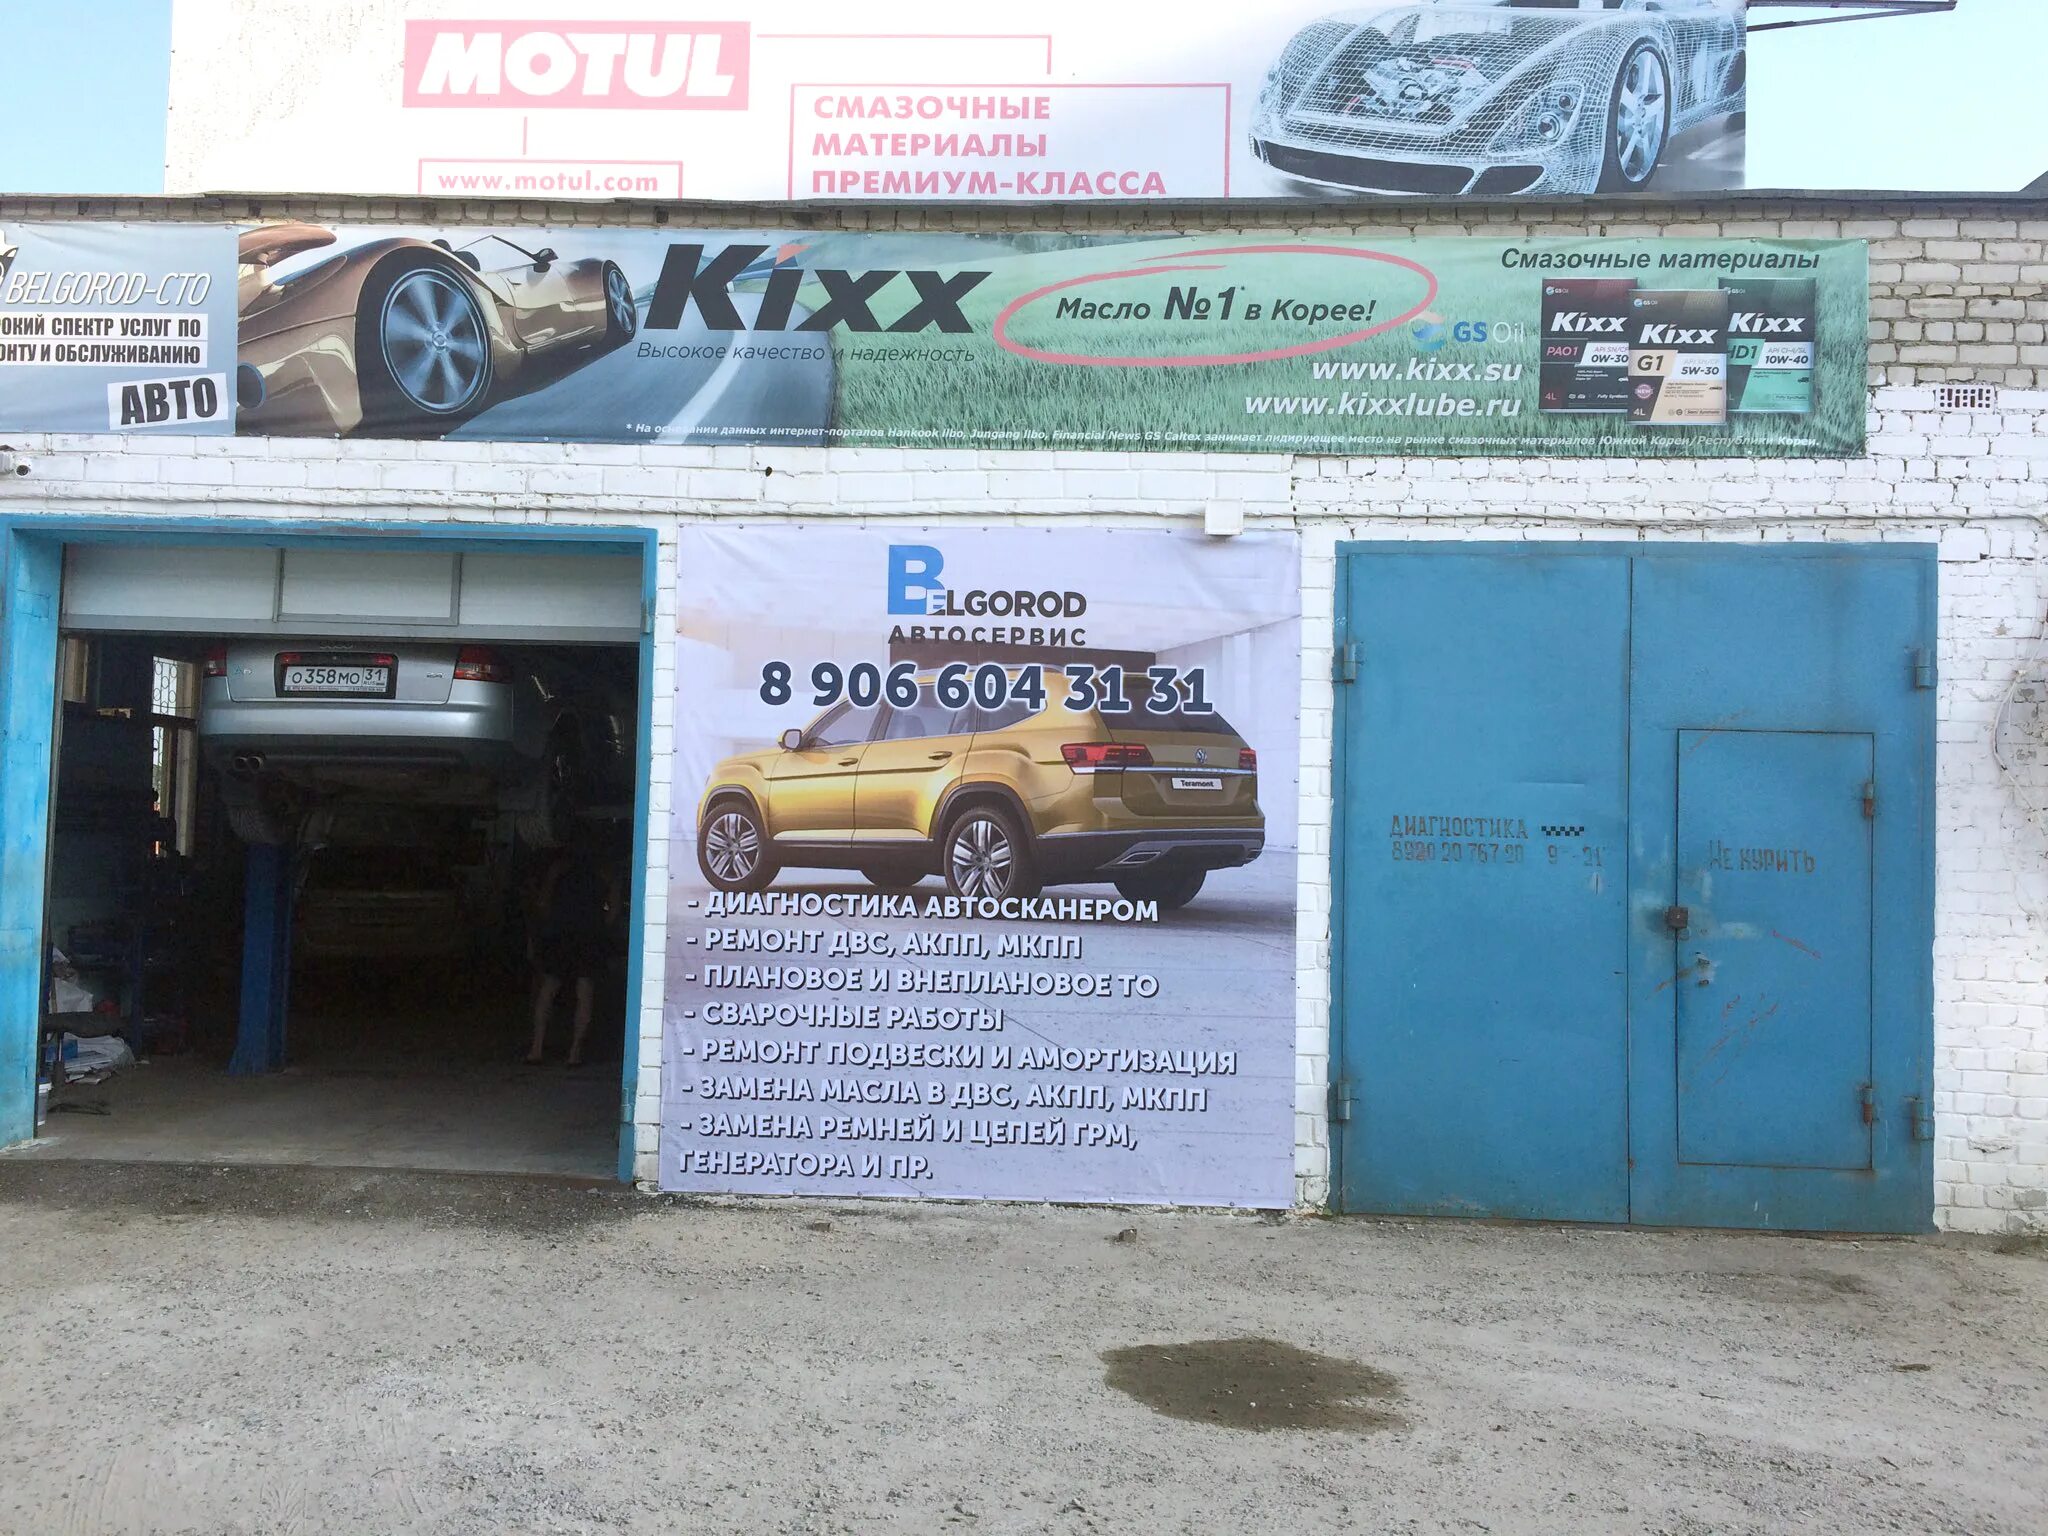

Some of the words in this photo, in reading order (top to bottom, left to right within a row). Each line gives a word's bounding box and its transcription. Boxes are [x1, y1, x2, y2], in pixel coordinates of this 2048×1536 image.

[418, 31, 736, 98] MOTUL
[813, 95, 1051, 120] СМАЗОЧНЫЕ
[812, 133, 1047, 157] МАТЕРИАЛЫ
[437, 169, 659, 193] www.motul.com
[812, 170, 1167, 196] ПРЕМИУМ-КЛАССА
[1501, 247, 1651, 269] Смазочные
[1658, 253, 1820, 272] материалы
[643, 243, 993, 334] Kixx
[1056, 297, 1151, 320] Масло
[1245, 303, 1261, 321] в
[1271, 299, 1377, 326] Корее!
[1550, 312, 1628, 332] Kixx
[1727, 312, 1806, 333] Kixx
[0, 313, 45, 336] ОКИЙ
[51, 317, 114, 336] СПЕКТР
[120, 318, 172, 337] УСЛУГ
[178, 319, 201, 338] ПО
[1453, 322, 1488, 344] GS
[1493, 321, 1525, 344] Oil
[1638, 323, 1719, 344] Kixx
[40, 343, 51, 362] И
[55, 344, 201, 364] ОБСЛУЖИВАНИЮ
[636, 341, 727, 360] Высокое
[733, 345, 826, 362] качество
[834, 349, 844, 362] и
[851, 347, 976, 363] надежность
[1591, 354, 1629, 363] 0W-30
[1637, 354, 1664, 371] G1
[1765, 355, 1809, 364] 10W-40
[1312, 357, 1522, 382] www.kixx.su
[1680, 366, 1720, 375] 5W-30
[121, 377, 218, 426] АВТО
[1245, 393, 1522, 417] www.kixxlube.ru
[1545, 392, 1557, 400] 4L
[1633, 407, 1646, 416] 4L
[635, 423, 651, 433] На
[720, 425, 766, 435] данных
[769, 426, 884, 438] интернет-порталов
[887, 428, 939, 437] Hankook
[969, 429, 1020, 441] Jungang
[1052, 430, 1105, 440] Financial
[1108, 431, 1141, 440] News
[1144, 431, 1162, 441] GS
[1164, 431, 1201, 442] Caltex
[1204, 433, 1262, 442] занимает
[1265, 434, 1345, 445] лидирующее
[1348, 435, 1383, 445] место
[1386, 436, 1401, 445] на
[1403, 435, 1445, 447] рынке
[1448, 436, 1517, 446] смазочных
[1520, 436, 1596, 447] материалов
[1599, 434, 1647, 446] Южной
[1777, 436, 1820, 447] Кореи.
[887, 544, 1088, 618] BELGOROD
[887, 624, 1087, 647] АВТОСЕРВИС
[364, 668, 383, 681] 31
[758, 660, 793, 707] 8
[810, 661, 920, 709] 906
[936, 663, 1047, 711] 604
[1063, 665, 1132, 713] 31
[1144, 666, 1214, 714] 31
[1180, 779, 1215, 788] Teramont
[1390, 814, 1529, 840] ДИАГНОСТИКА
[704, 890, 919, 918] ДИАГНОСТИКА
[924, 895, 1159, 922] АВТОСКАНЕРОМ
[704, 928, 823, 953] РЕМОНТ
[828, 931, 896, 958] ДВС,
[902, 932, 990, 960] АКПП,
[997, 934, 1083, 959] МКПП
[703, 964, 863, 991] ПЛАНОВОЕ
[869, 967, 890, 991] И
[896, 968, 1112, 997] ВНЕПЛАНОВОЕ
[1118, 973, 1160, 998] ТО
[702, 1002, 881, 1029] СВАРОЧНЫЕ
[886, 1006, 1004, 1031] РАБОТЫ
[702, 1038, 821, 1065] РЕМОНТ
[826, 1042, 984, 1069] ПОДВЕСКИ
[990, 1045, 1012, 1069] И
[1017, 1046, 1238, 1077] АМОРТИЗАЦИЯ
[699, 1076, 815, 1102] ЗАМЕНА
[820, 1079, 921, 1104] МАСЛА
[927, 1081, 946, 1104] В
[950, 1081, 1020, 1110] ДВС,
[1025, 1084, 1115, 1111] АКПП,
[1121, 1086, 1208, 1112] МКПП
[698, 1112, 813, 1139] ЗАМЕНА
[819, 1113, 935, 1142] РЕМНЕЙ
[942, 1118, 963, 1142] И
[970, 1116, 1066, 1147] ЦЕПЕЙ
[1072, 1122, 1138, 1150] ГРМ,
[678, 1150, 854, 1177] ГЕНЕРАТОРА
[861, 1154, 882, 1178] И
[888, 1155, 934, 1180] ПР.
